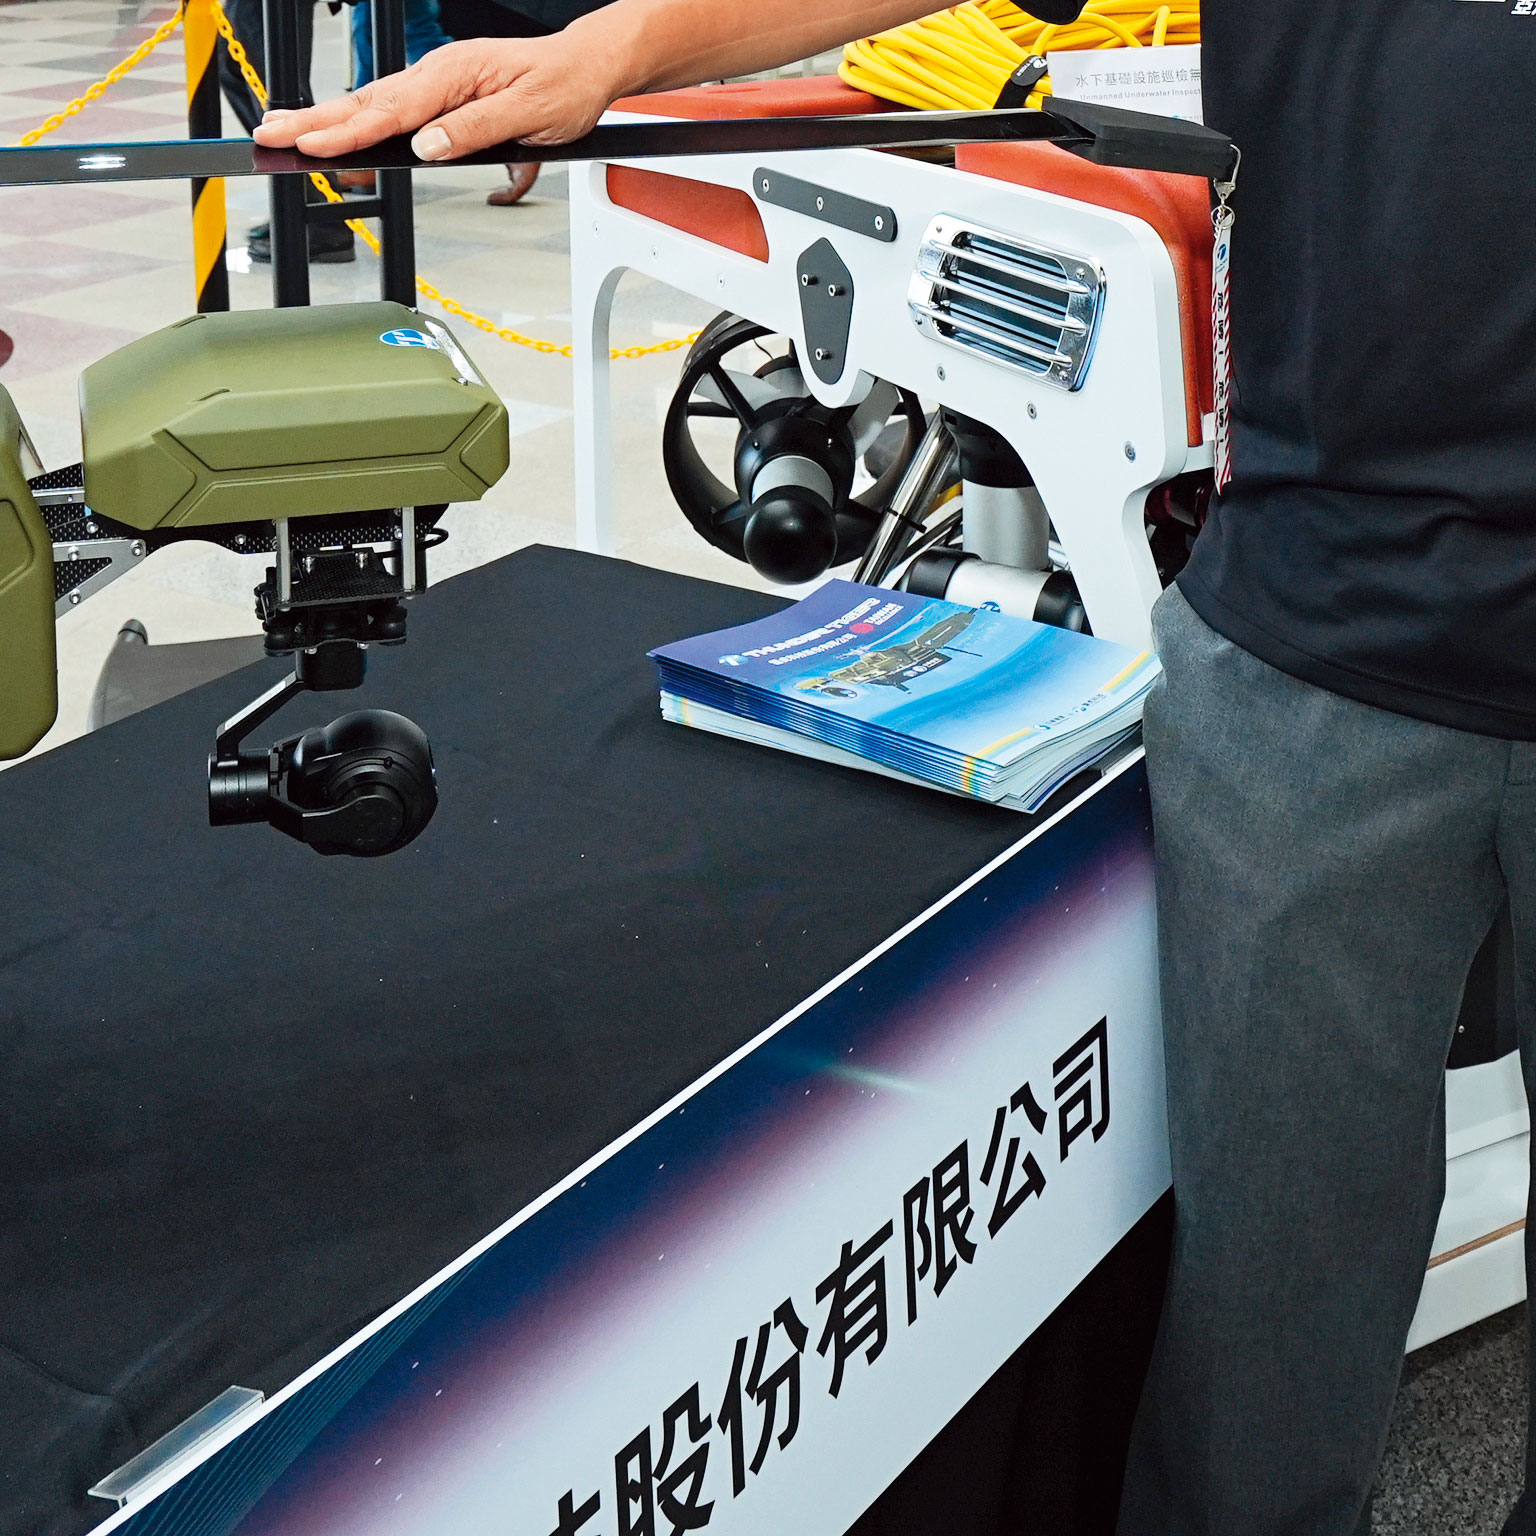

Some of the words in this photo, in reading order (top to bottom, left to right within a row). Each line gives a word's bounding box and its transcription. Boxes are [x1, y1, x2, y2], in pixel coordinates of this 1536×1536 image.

[1075, 68, 1201, 88] 水下基礎設施巡檢無
